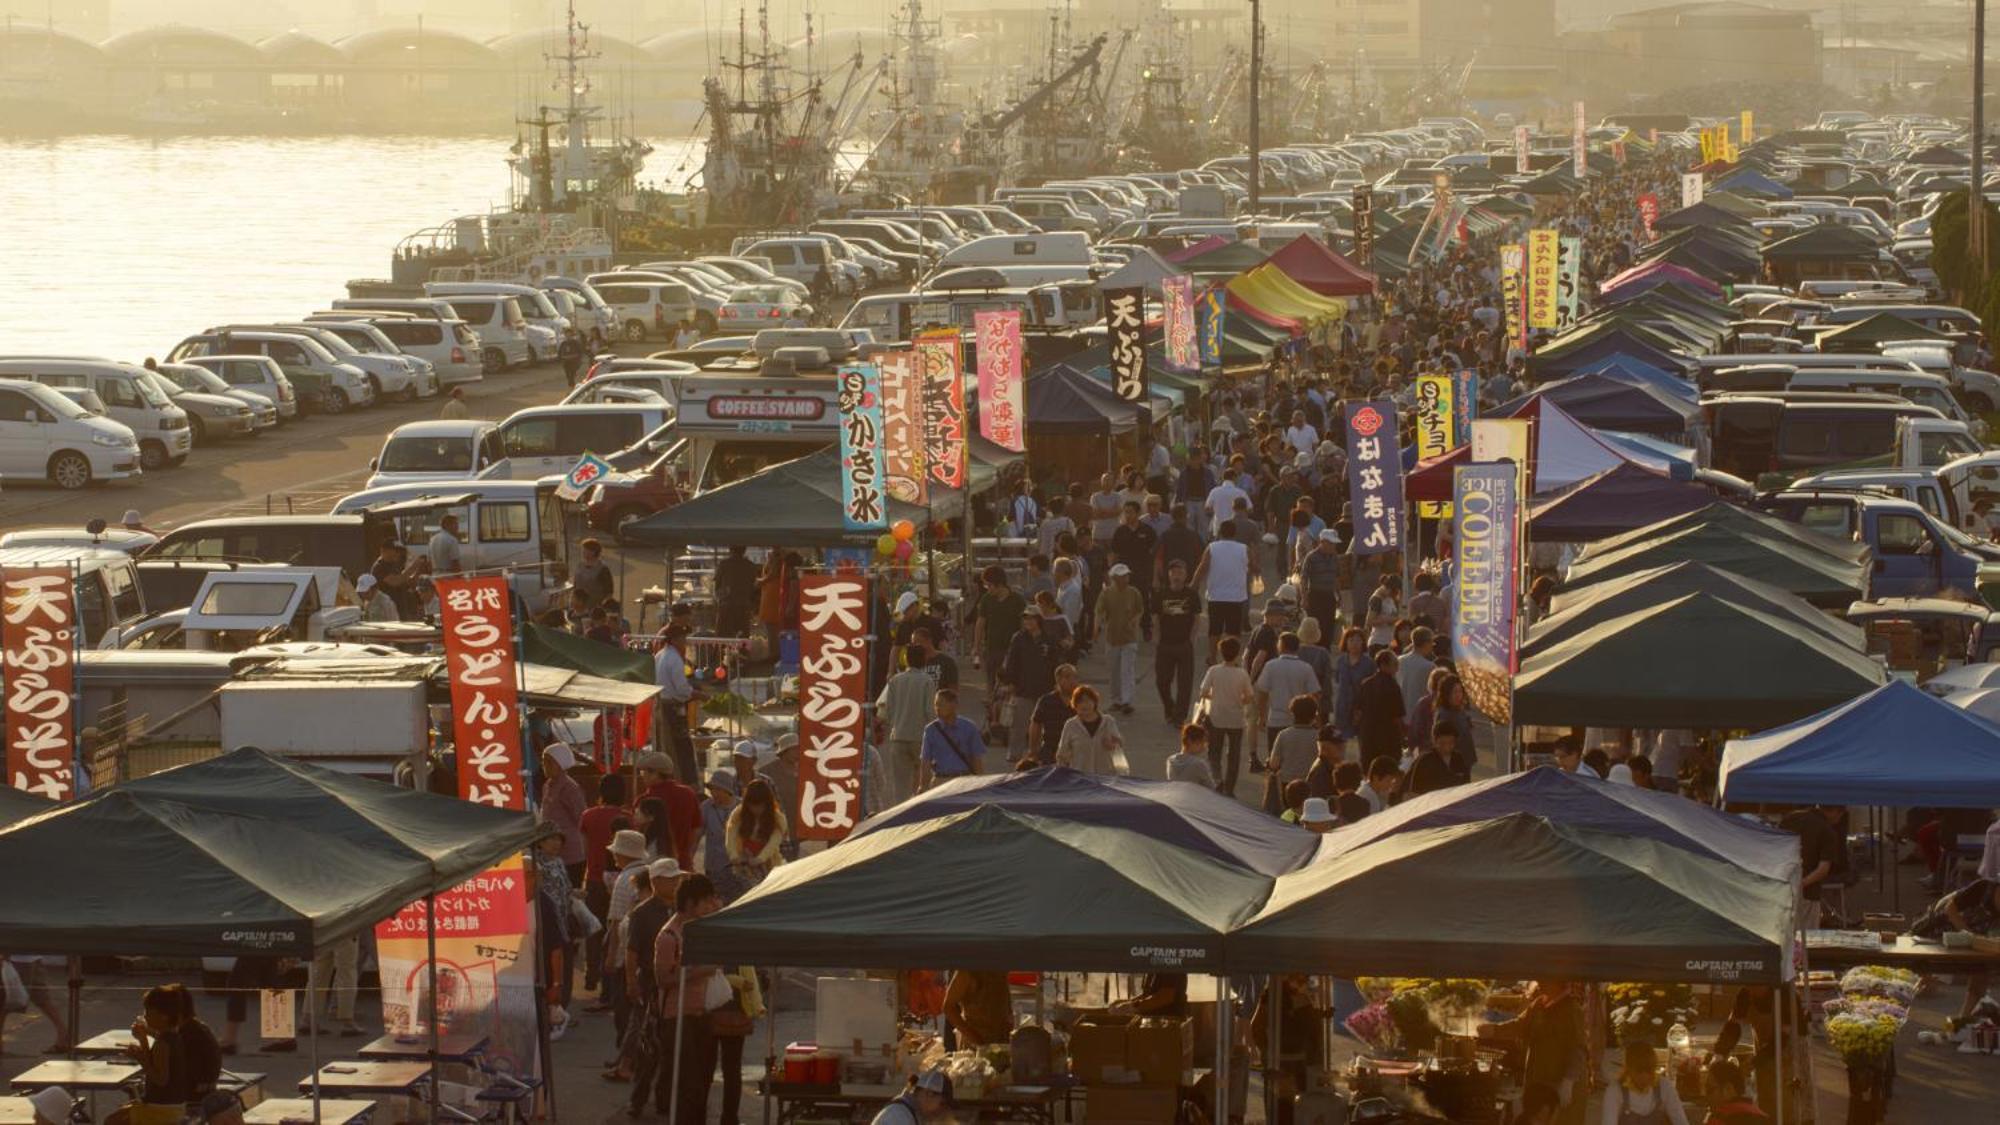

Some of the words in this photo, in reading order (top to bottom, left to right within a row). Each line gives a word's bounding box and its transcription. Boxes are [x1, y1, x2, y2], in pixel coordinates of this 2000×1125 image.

[1110, 293, 1143, 400] 天ぷら
[716, 400, 766, 415] COFFEE
[767, 400, 816, 416] STAND
[847, 412, 881, 524] かき氷
[447, 588, 502, 610] 名代
[801, 582, 864, 829] 天ぷらそば
[221, 930, 267, 942] CAPTAIN
[268, 931, 296, 942] STAG
[1130, 945, 1177, 957] CAPTAIN
[1178, 948, 1206, 958] STAG
[1685, 960, 1734, 970] CAPTAIN
[1735, 960, 1764, 971] STAG
